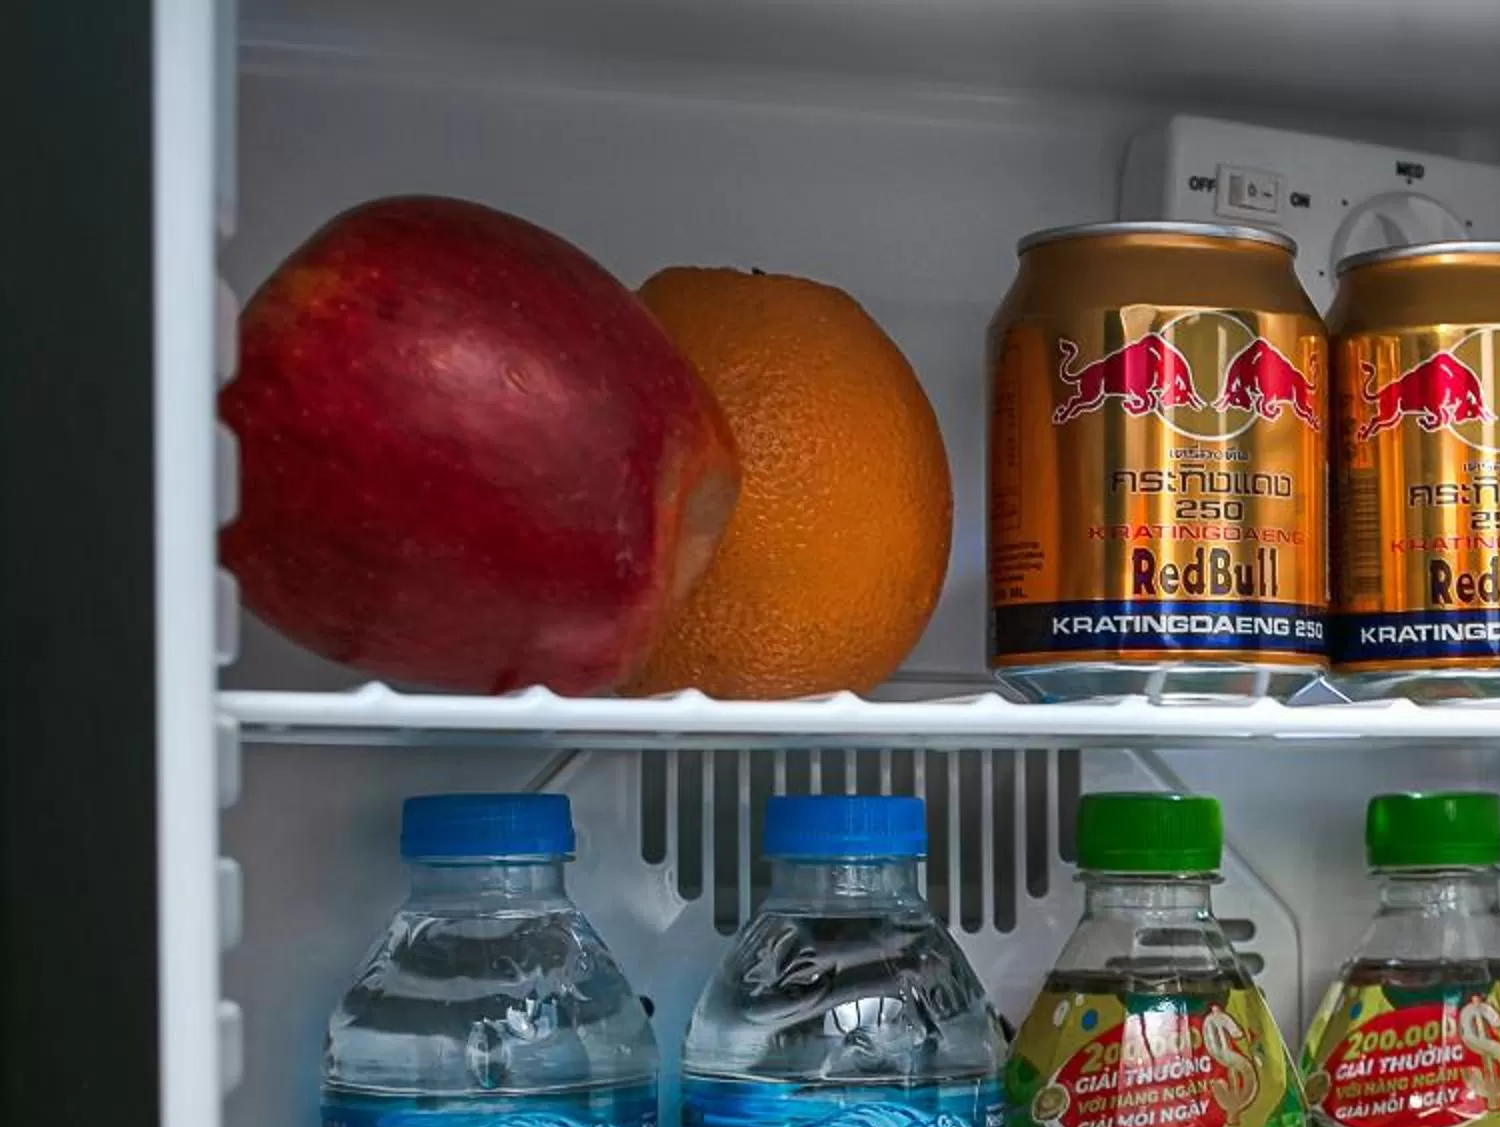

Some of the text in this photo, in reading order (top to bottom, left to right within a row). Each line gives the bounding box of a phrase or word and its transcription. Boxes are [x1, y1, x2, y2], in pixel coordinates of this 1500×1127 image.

[1187, 175, 1217, 193] OFF
[1289, 191, 1311, 208] ON
[1175, 500, 1243, 520] 250
[1088, 524, 1306, 545] KRATINGDAENG
[1052, 614, 1324, 639] KRATINGDAENG 250
